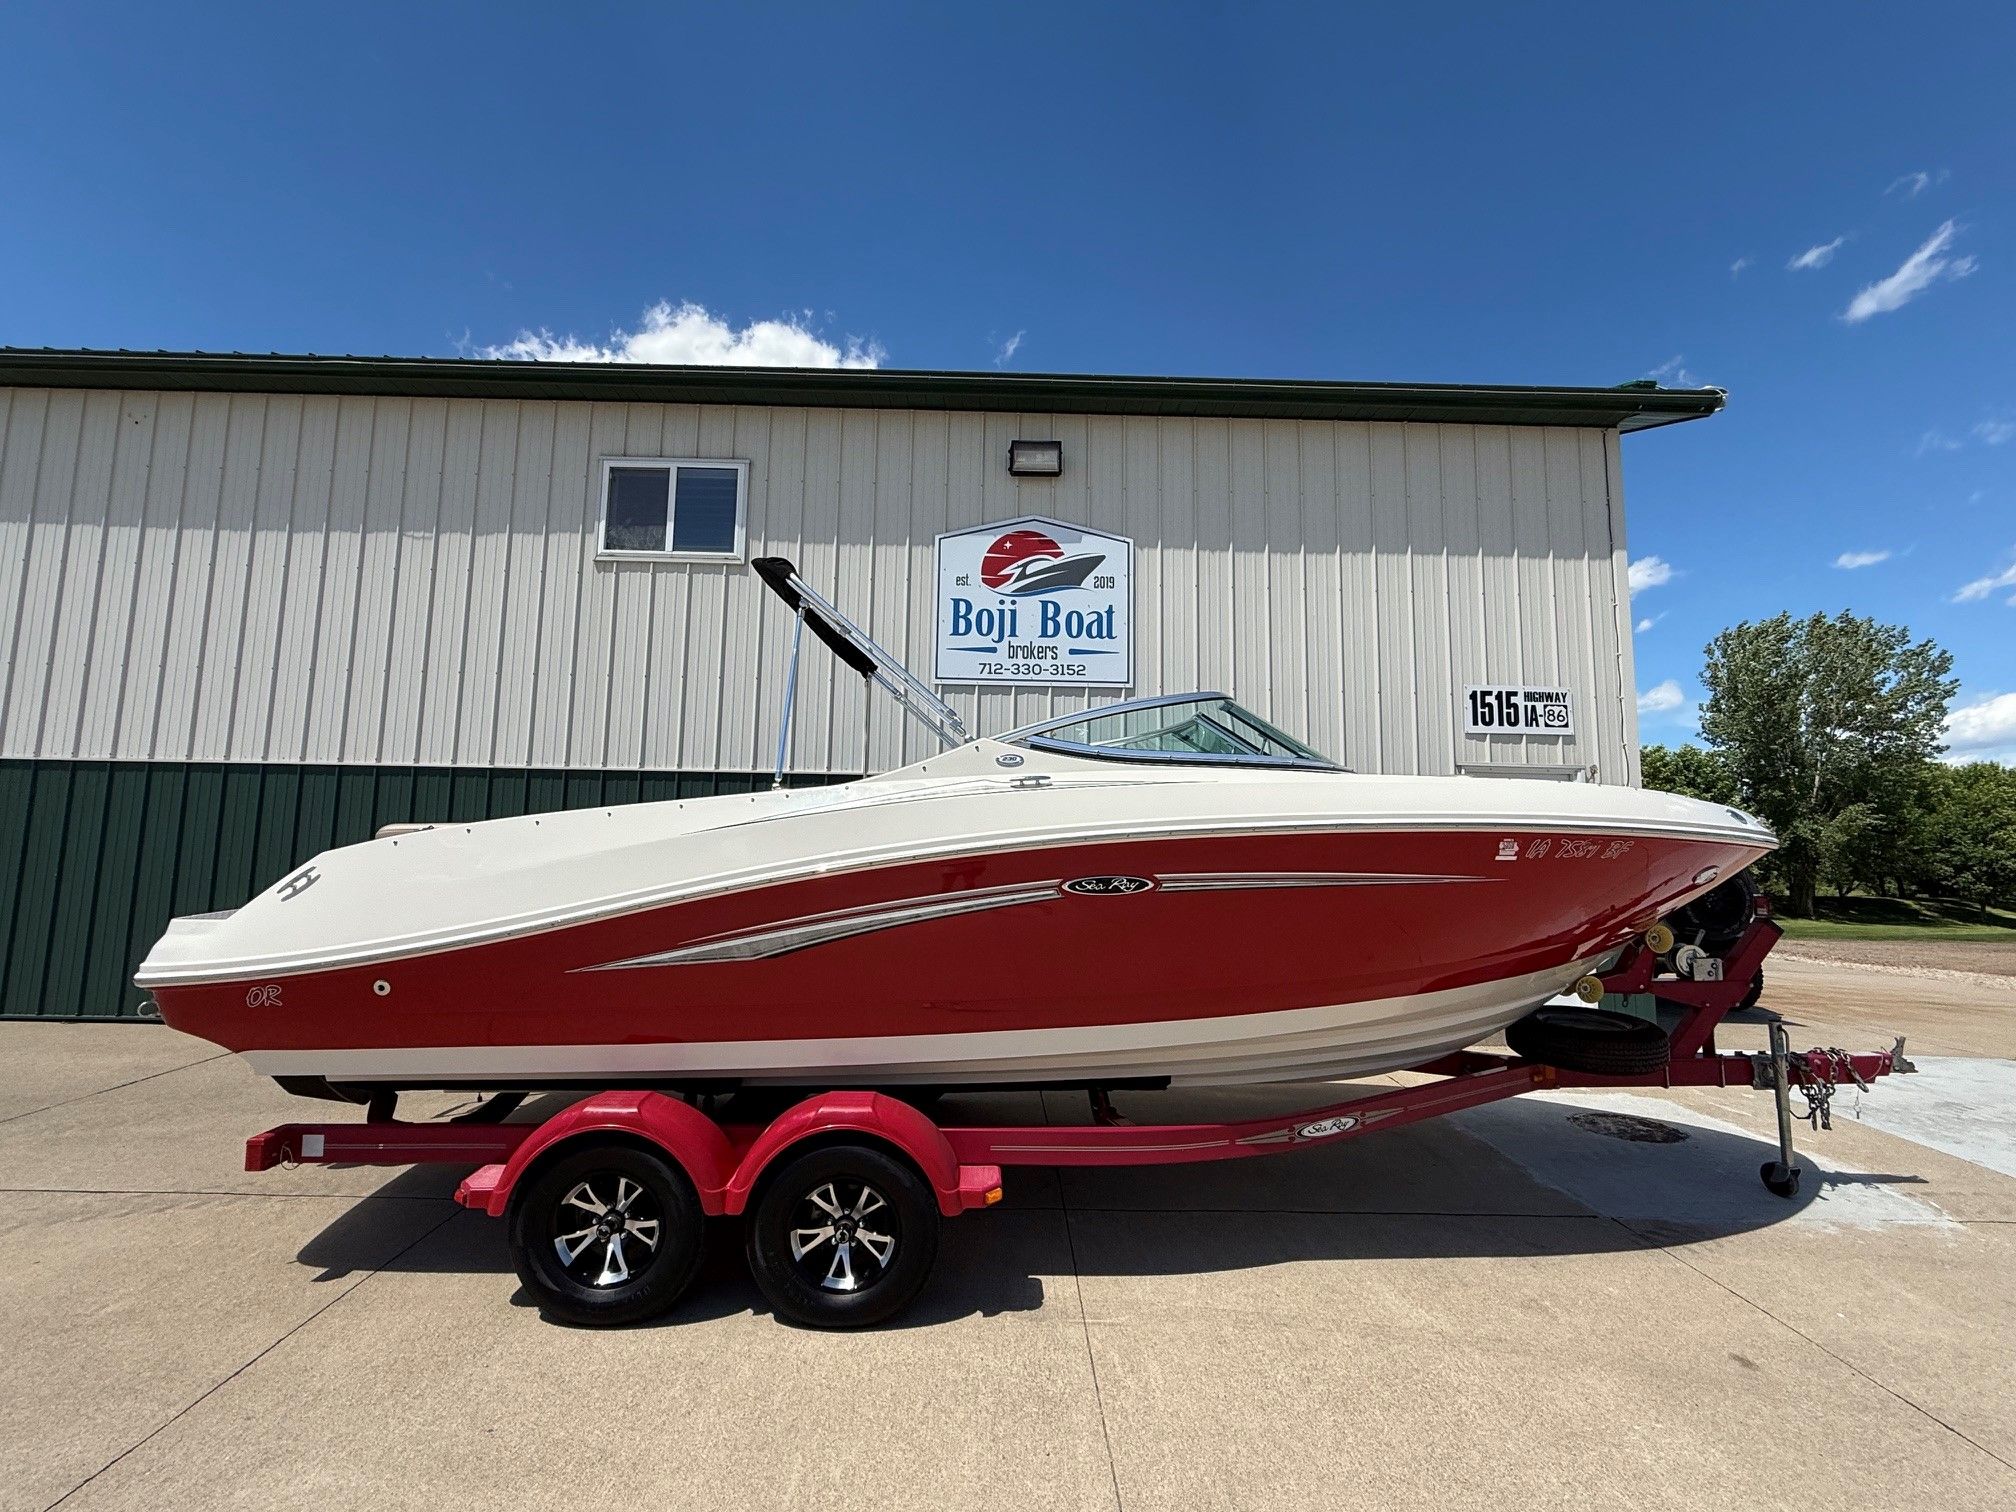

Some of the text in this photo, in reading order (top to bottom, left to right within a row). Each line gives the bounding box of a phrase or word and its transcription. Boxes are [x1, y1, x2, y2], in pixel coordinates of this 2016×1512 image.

[955, 573, 972, 587] est.
[1093, 575, 1115, 589] 2019
[949, 597, 1118, 643] Boji Boat
[1008, 641, 1058, 660] brokers
[978, 662, 1086, 676] 712-330-3152
[1523, 691, 1568, 703] HIGHWAY
[1469, 690, 1520, 727] 1515
[1075, 877, 1140, 892] Sea Ray
[246, 984, 283, 1008] OR
[1307, 1118, 1351, 1135] Sea Ray
